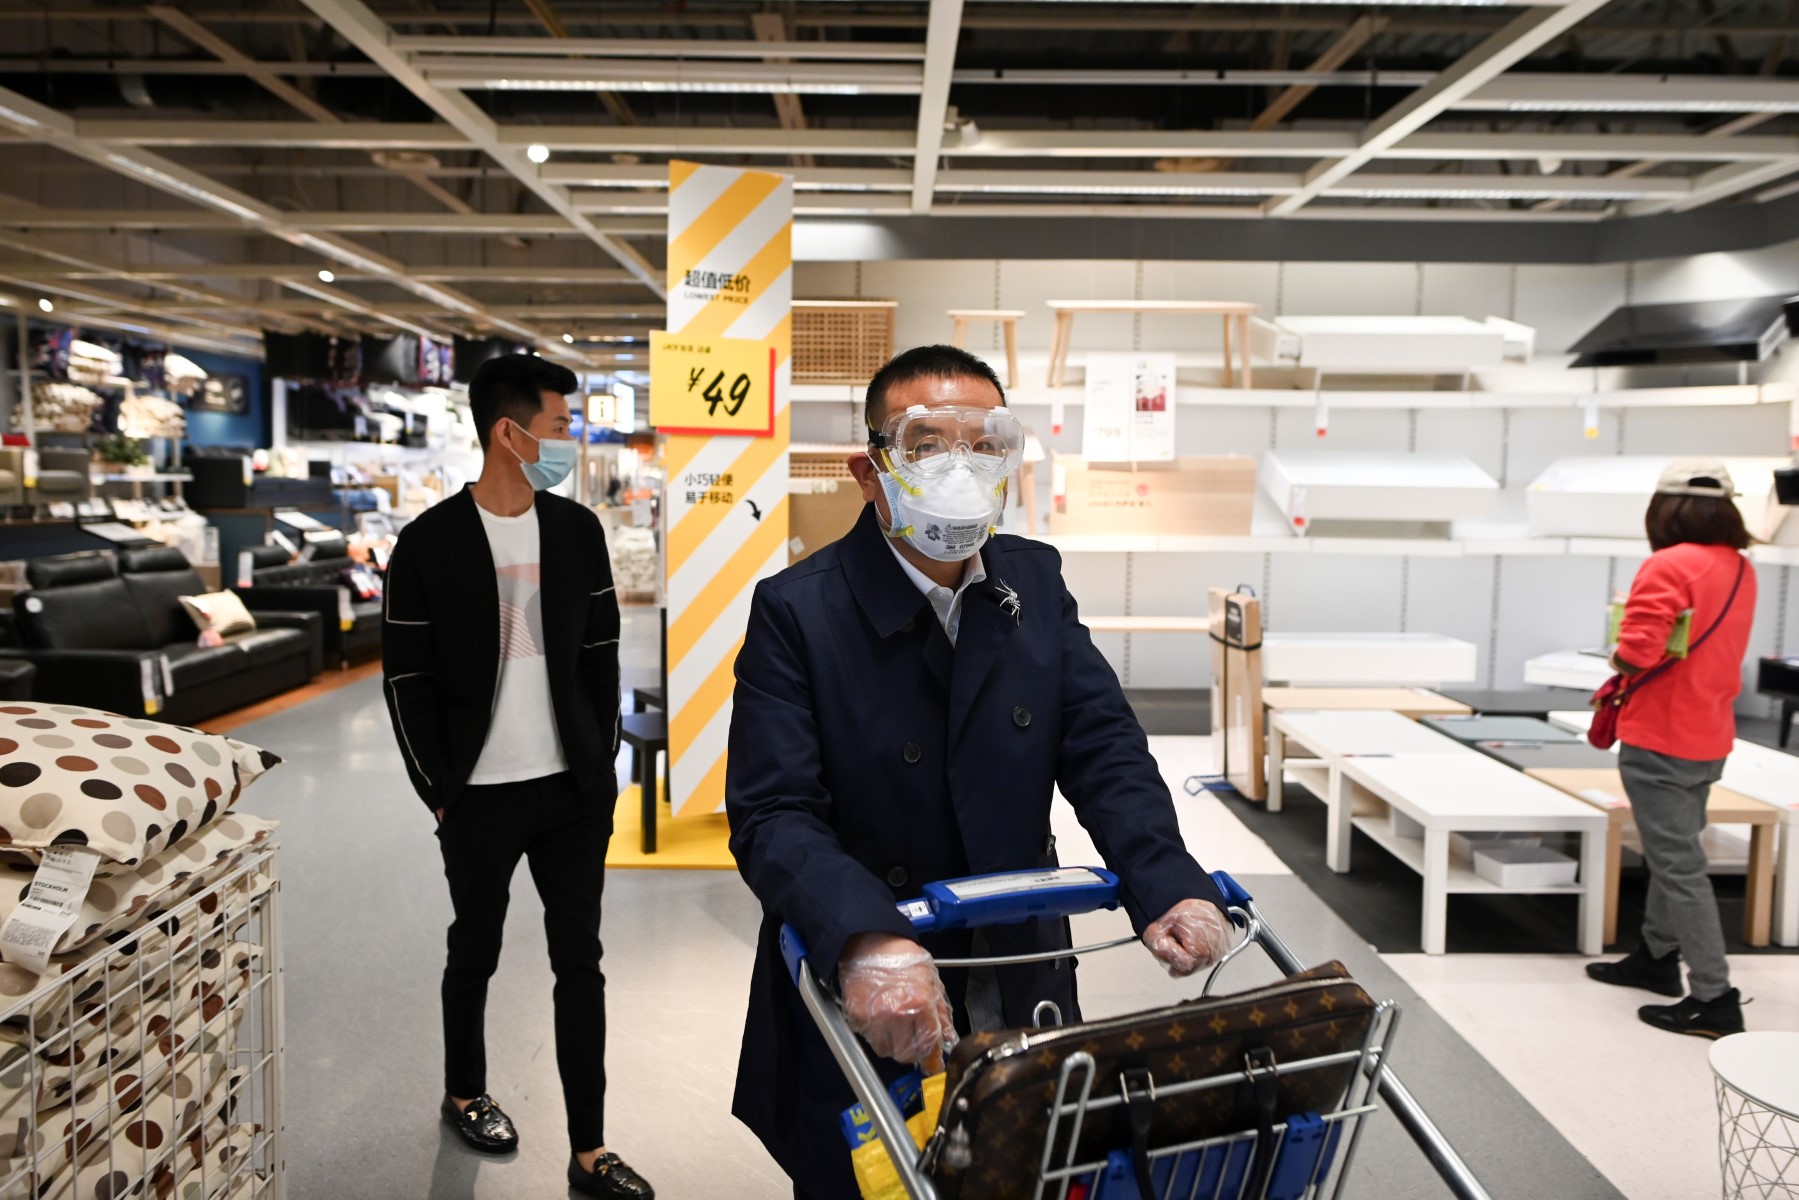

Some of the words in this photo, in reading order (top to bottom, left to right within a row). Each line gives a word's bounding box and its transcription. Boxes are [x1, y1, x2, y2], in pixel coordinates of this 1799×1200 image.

[685, 270, 750, 292] 超值低价
[685, 473, 733, 486] 小巧轻便
[685, 491, 733, 504] 易于移动
[34, 881, 68, 892] STOCKHOLM
